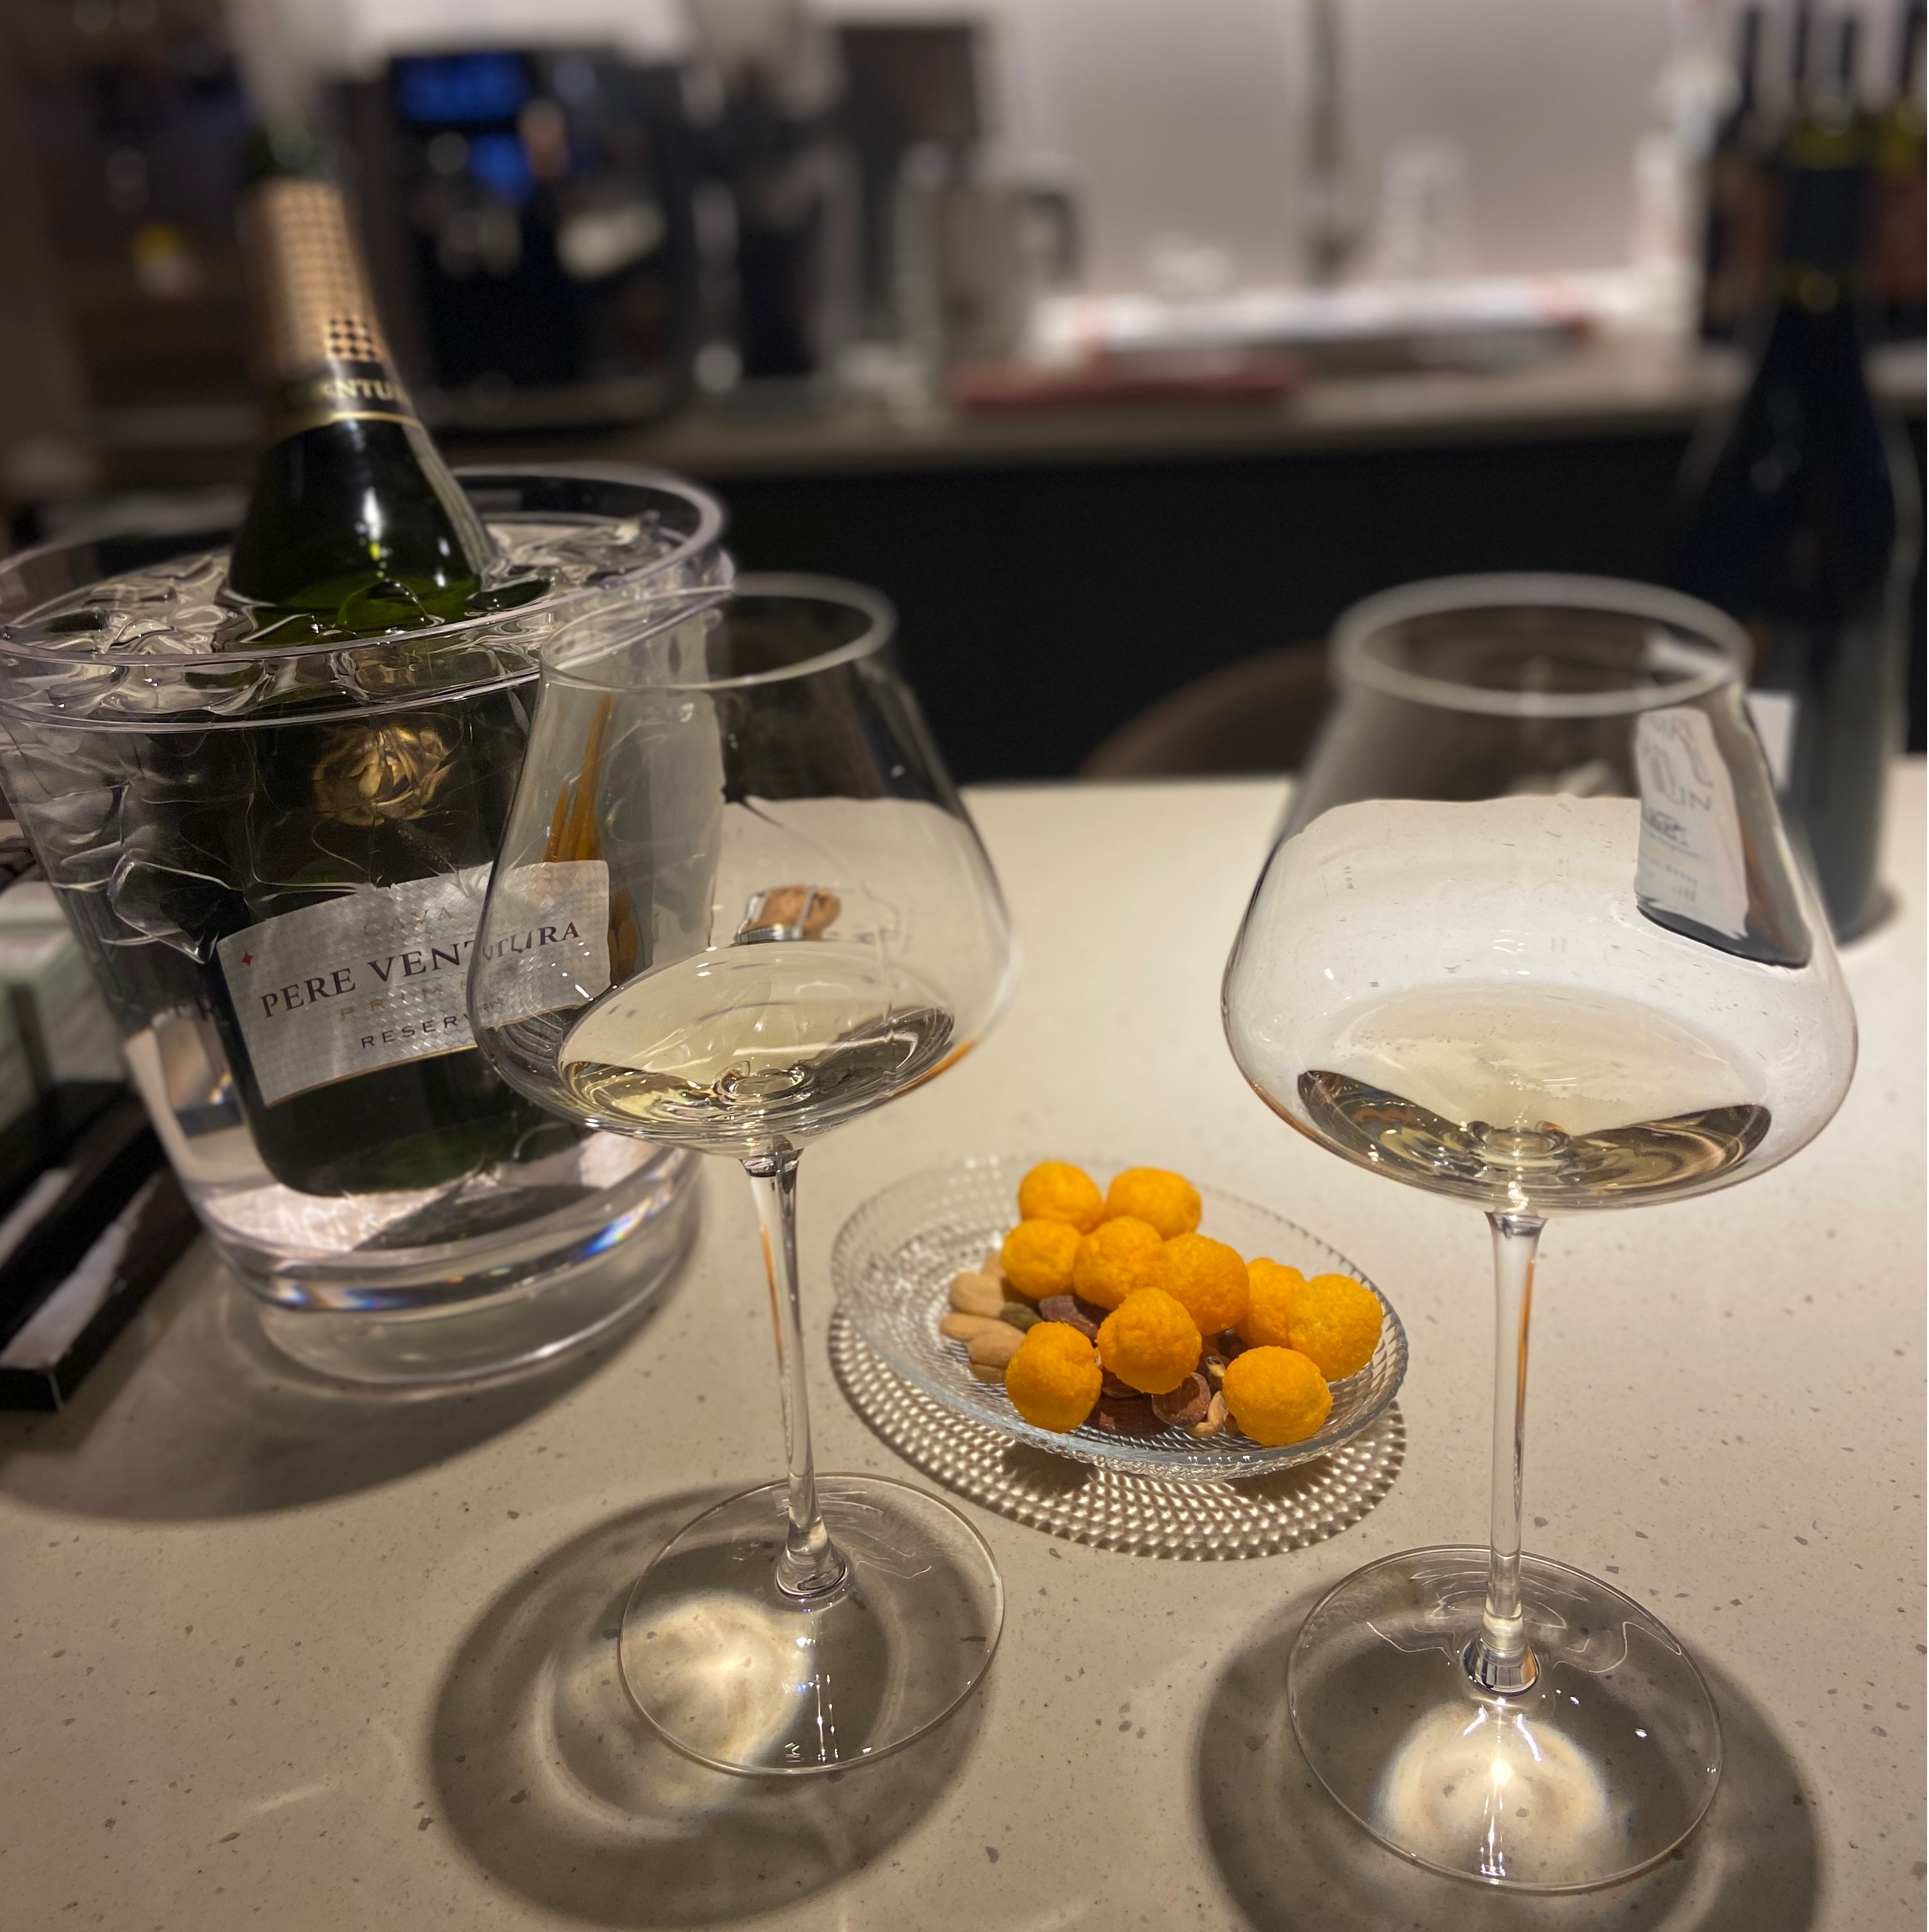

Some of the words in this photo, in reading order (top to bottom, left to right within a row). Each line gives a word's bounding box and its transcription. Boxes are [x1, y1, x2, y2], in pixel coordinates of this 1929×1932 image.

[259, 967, 356, 1019] PERE
[367, 922, 581, 983] VENTURA
[361, 1014, 470, 1049] RESER
